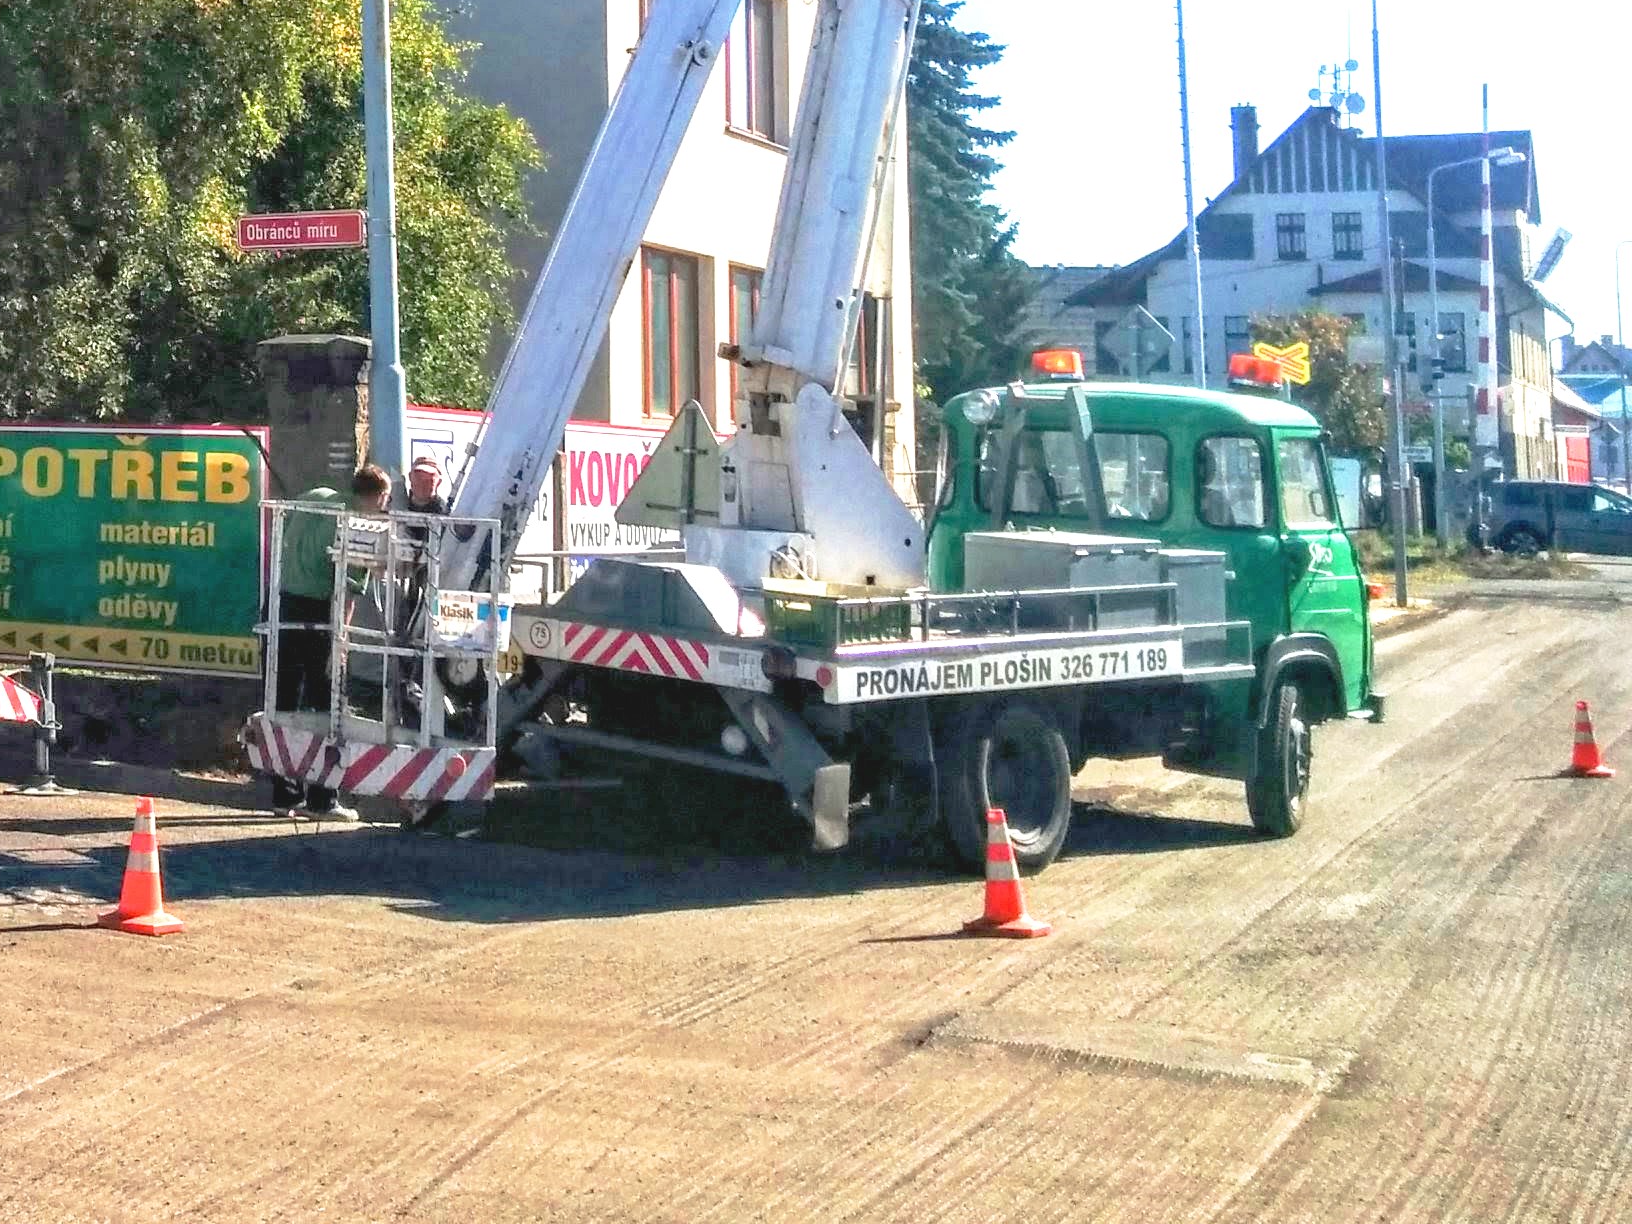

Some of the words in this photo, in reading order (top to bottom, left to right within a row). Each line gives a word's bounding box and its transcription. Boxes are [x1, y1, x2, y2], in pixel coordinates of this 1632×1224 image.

[246, 222, 301, 241] Obránců
[307, 221, 338, 238] míru
[100, 520, 216, 548] materiál
[98, 556, 171, 588] plyny
[98, 592, 178, 625] oděvy
[534, 626, 546, 638] 75
[139, 636, 168, 659] 70
[179, 642, 254, 666] metrů
[856, 661, 974, 698] PRONÁJEM
[980, 653, 1052, 687] PLOŠIN
[1060, 652, 1093, 679] 326
[1098, 649, 1130, 676] 771
[1137, 647, 1168, 674] 189
